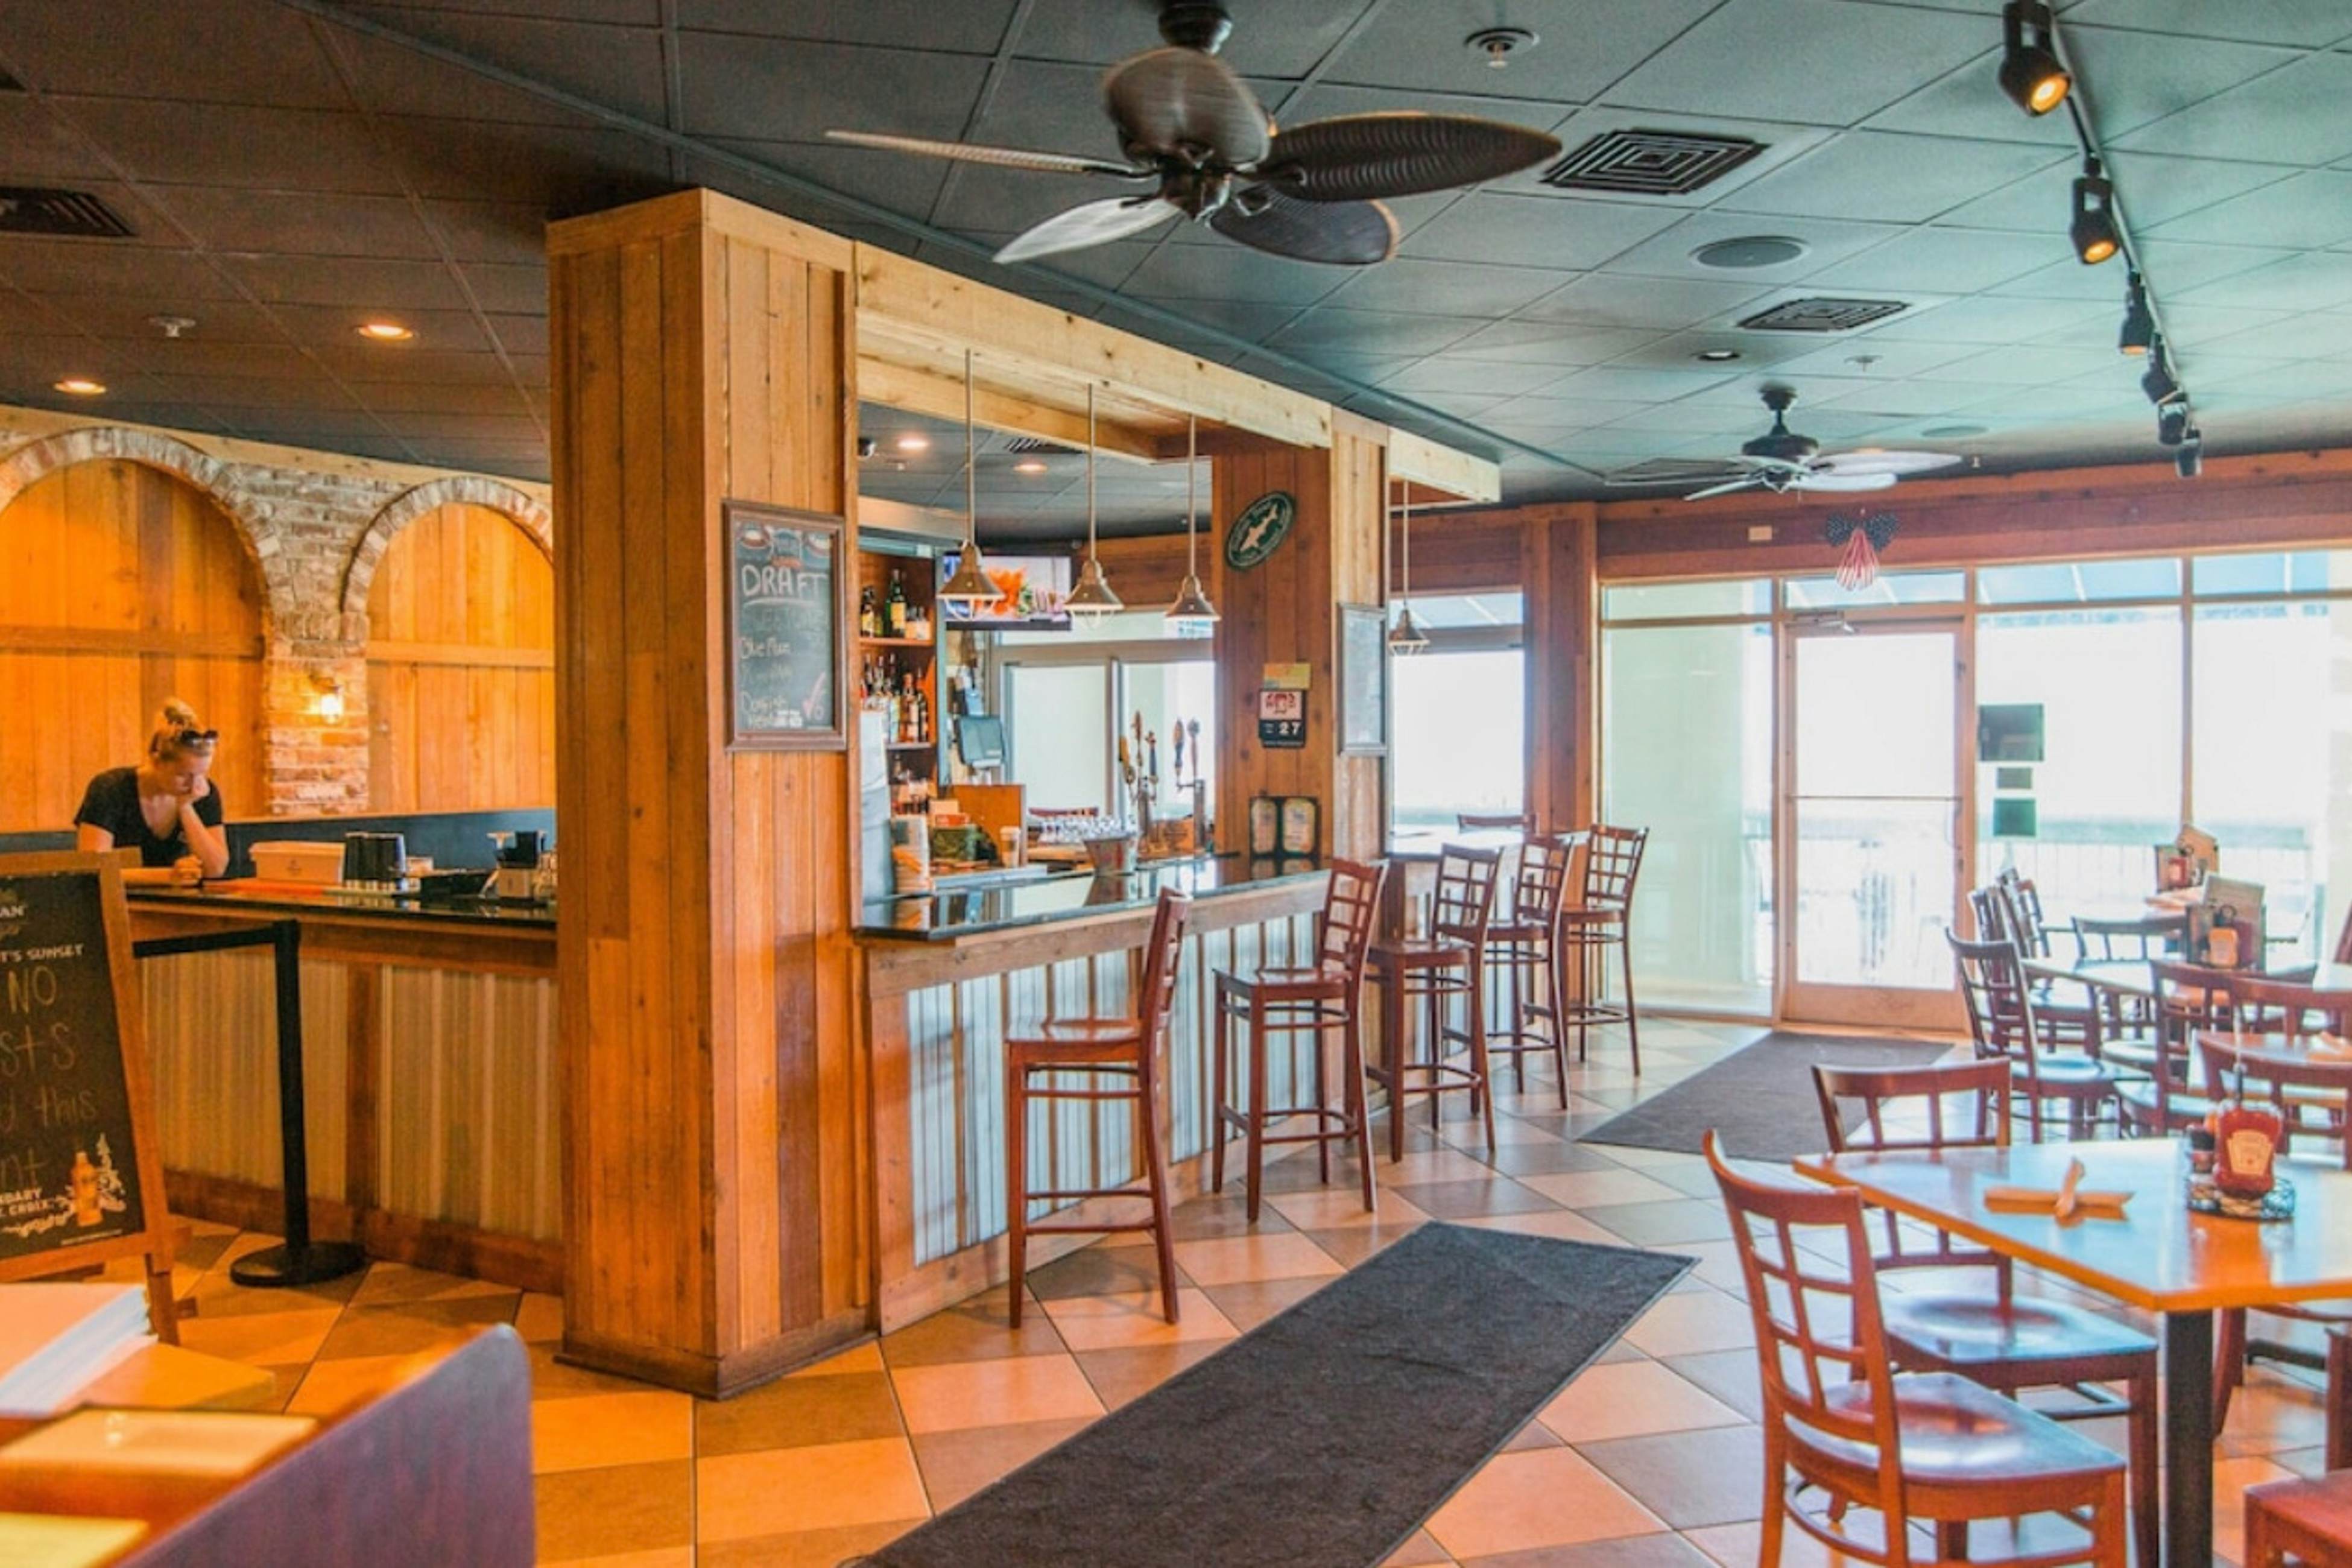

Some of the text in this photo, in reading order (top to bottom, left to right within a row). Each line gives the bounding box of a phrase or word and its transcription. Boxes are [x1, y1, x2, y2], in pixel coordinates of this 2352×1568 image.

[741, 564, 829, 598] DRAFT
[1279, 721, 1301, 735] 27
[27, 943, 84, 961] SUNSET
[8, 966, 57, 1014] NO
